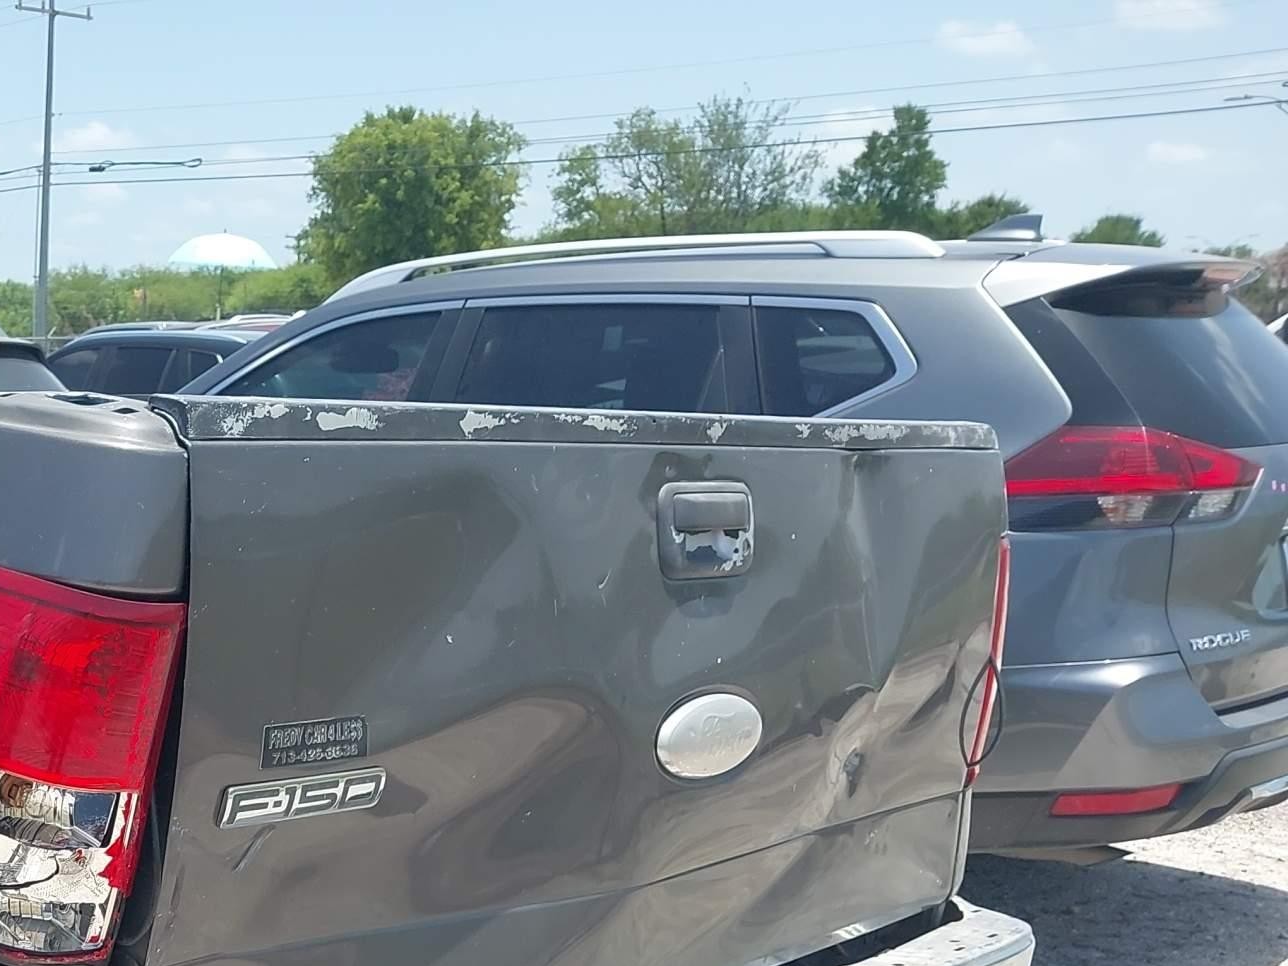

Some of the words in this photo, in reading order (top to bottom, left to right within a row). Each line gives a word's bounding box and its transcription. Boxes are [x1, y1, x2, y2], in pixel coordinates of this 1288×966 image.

[1189, 629, 1251, 651] ROGUE
[268, 726, 305, 750] FREDY
[305, 723, 328, 746] CAR
[328, 724, 335, 742] 4
